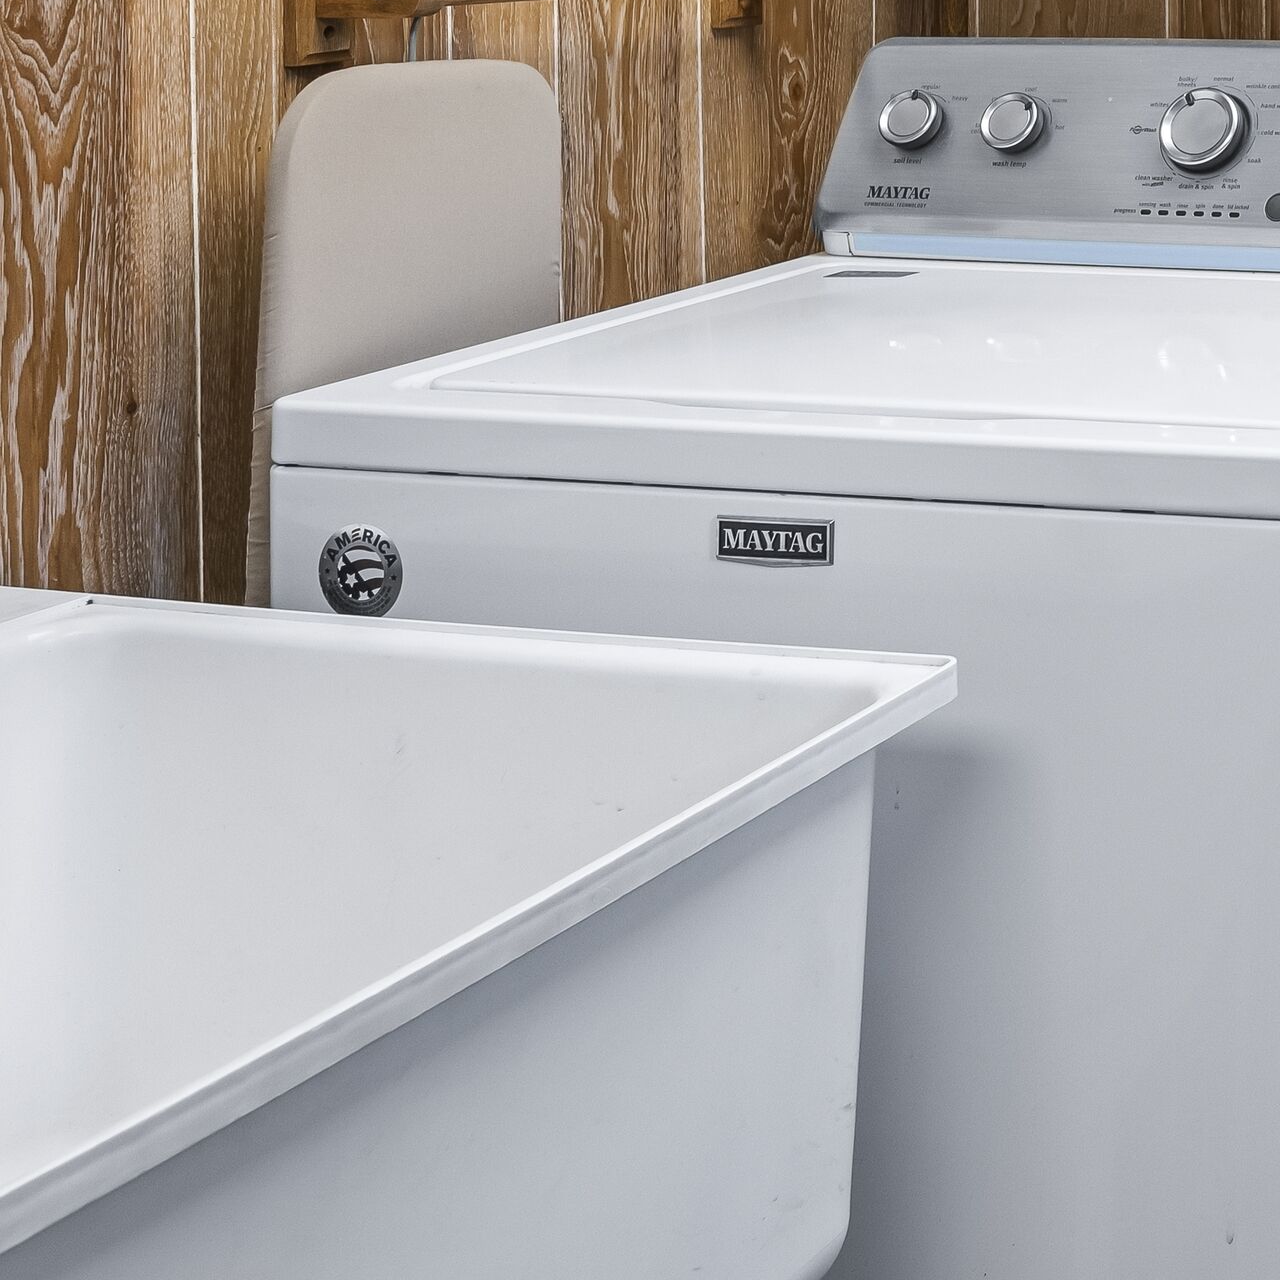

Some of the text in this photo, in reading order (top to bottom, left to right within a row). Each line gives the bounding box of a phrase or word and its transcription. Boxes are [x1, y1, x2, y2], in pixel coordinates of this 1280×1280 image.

[906, 157, 922, 165] level
[1010, 161, 1027, 169] temp
[867, 185, 930, 200] MAYTAG
[326, 527, 397, 568] AMERICA
[722, 528, 824, 553] MAYTAG
